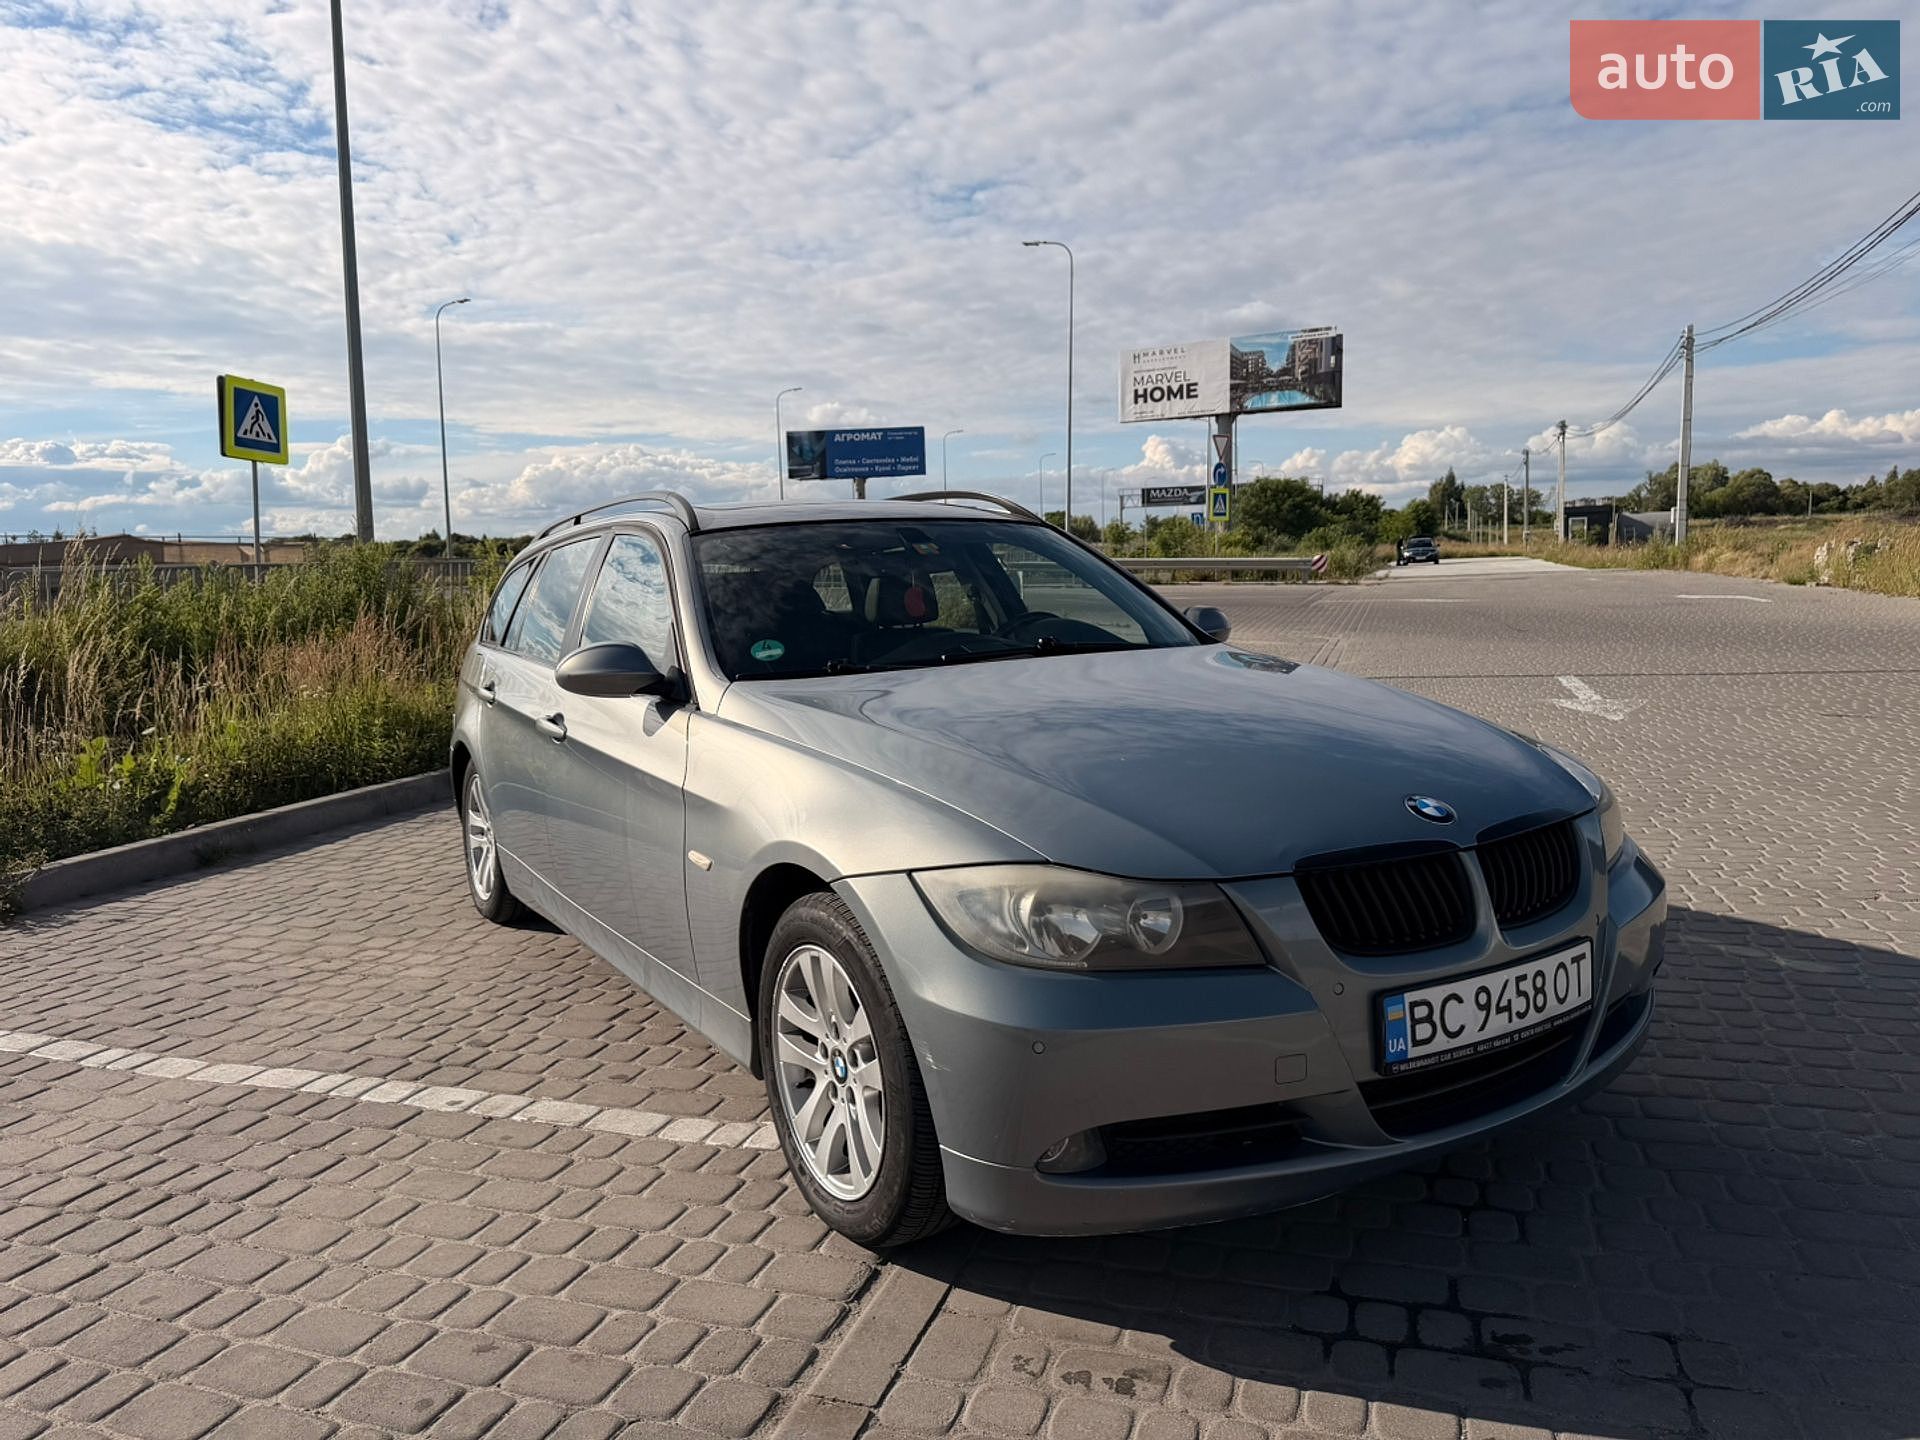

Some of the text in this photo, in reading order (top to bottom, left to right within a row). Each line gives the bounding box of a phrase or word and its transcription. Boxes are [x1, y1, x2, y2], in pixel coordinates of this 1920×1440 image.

[1133, 370, 1191, 388] MARVEL
[1133, 382, 1199, 405] HOME
[834, 432, 883, 442] АГРОМАТ
[1150, 488, 1189, 498] MAZDA
[1408, 993, 1466, 1048] BC
[1474, 970, 1547, 1032] 9458
[1553, 952, 1587, 1006] OT
[1388, 1037, 1406, 1054] UA
